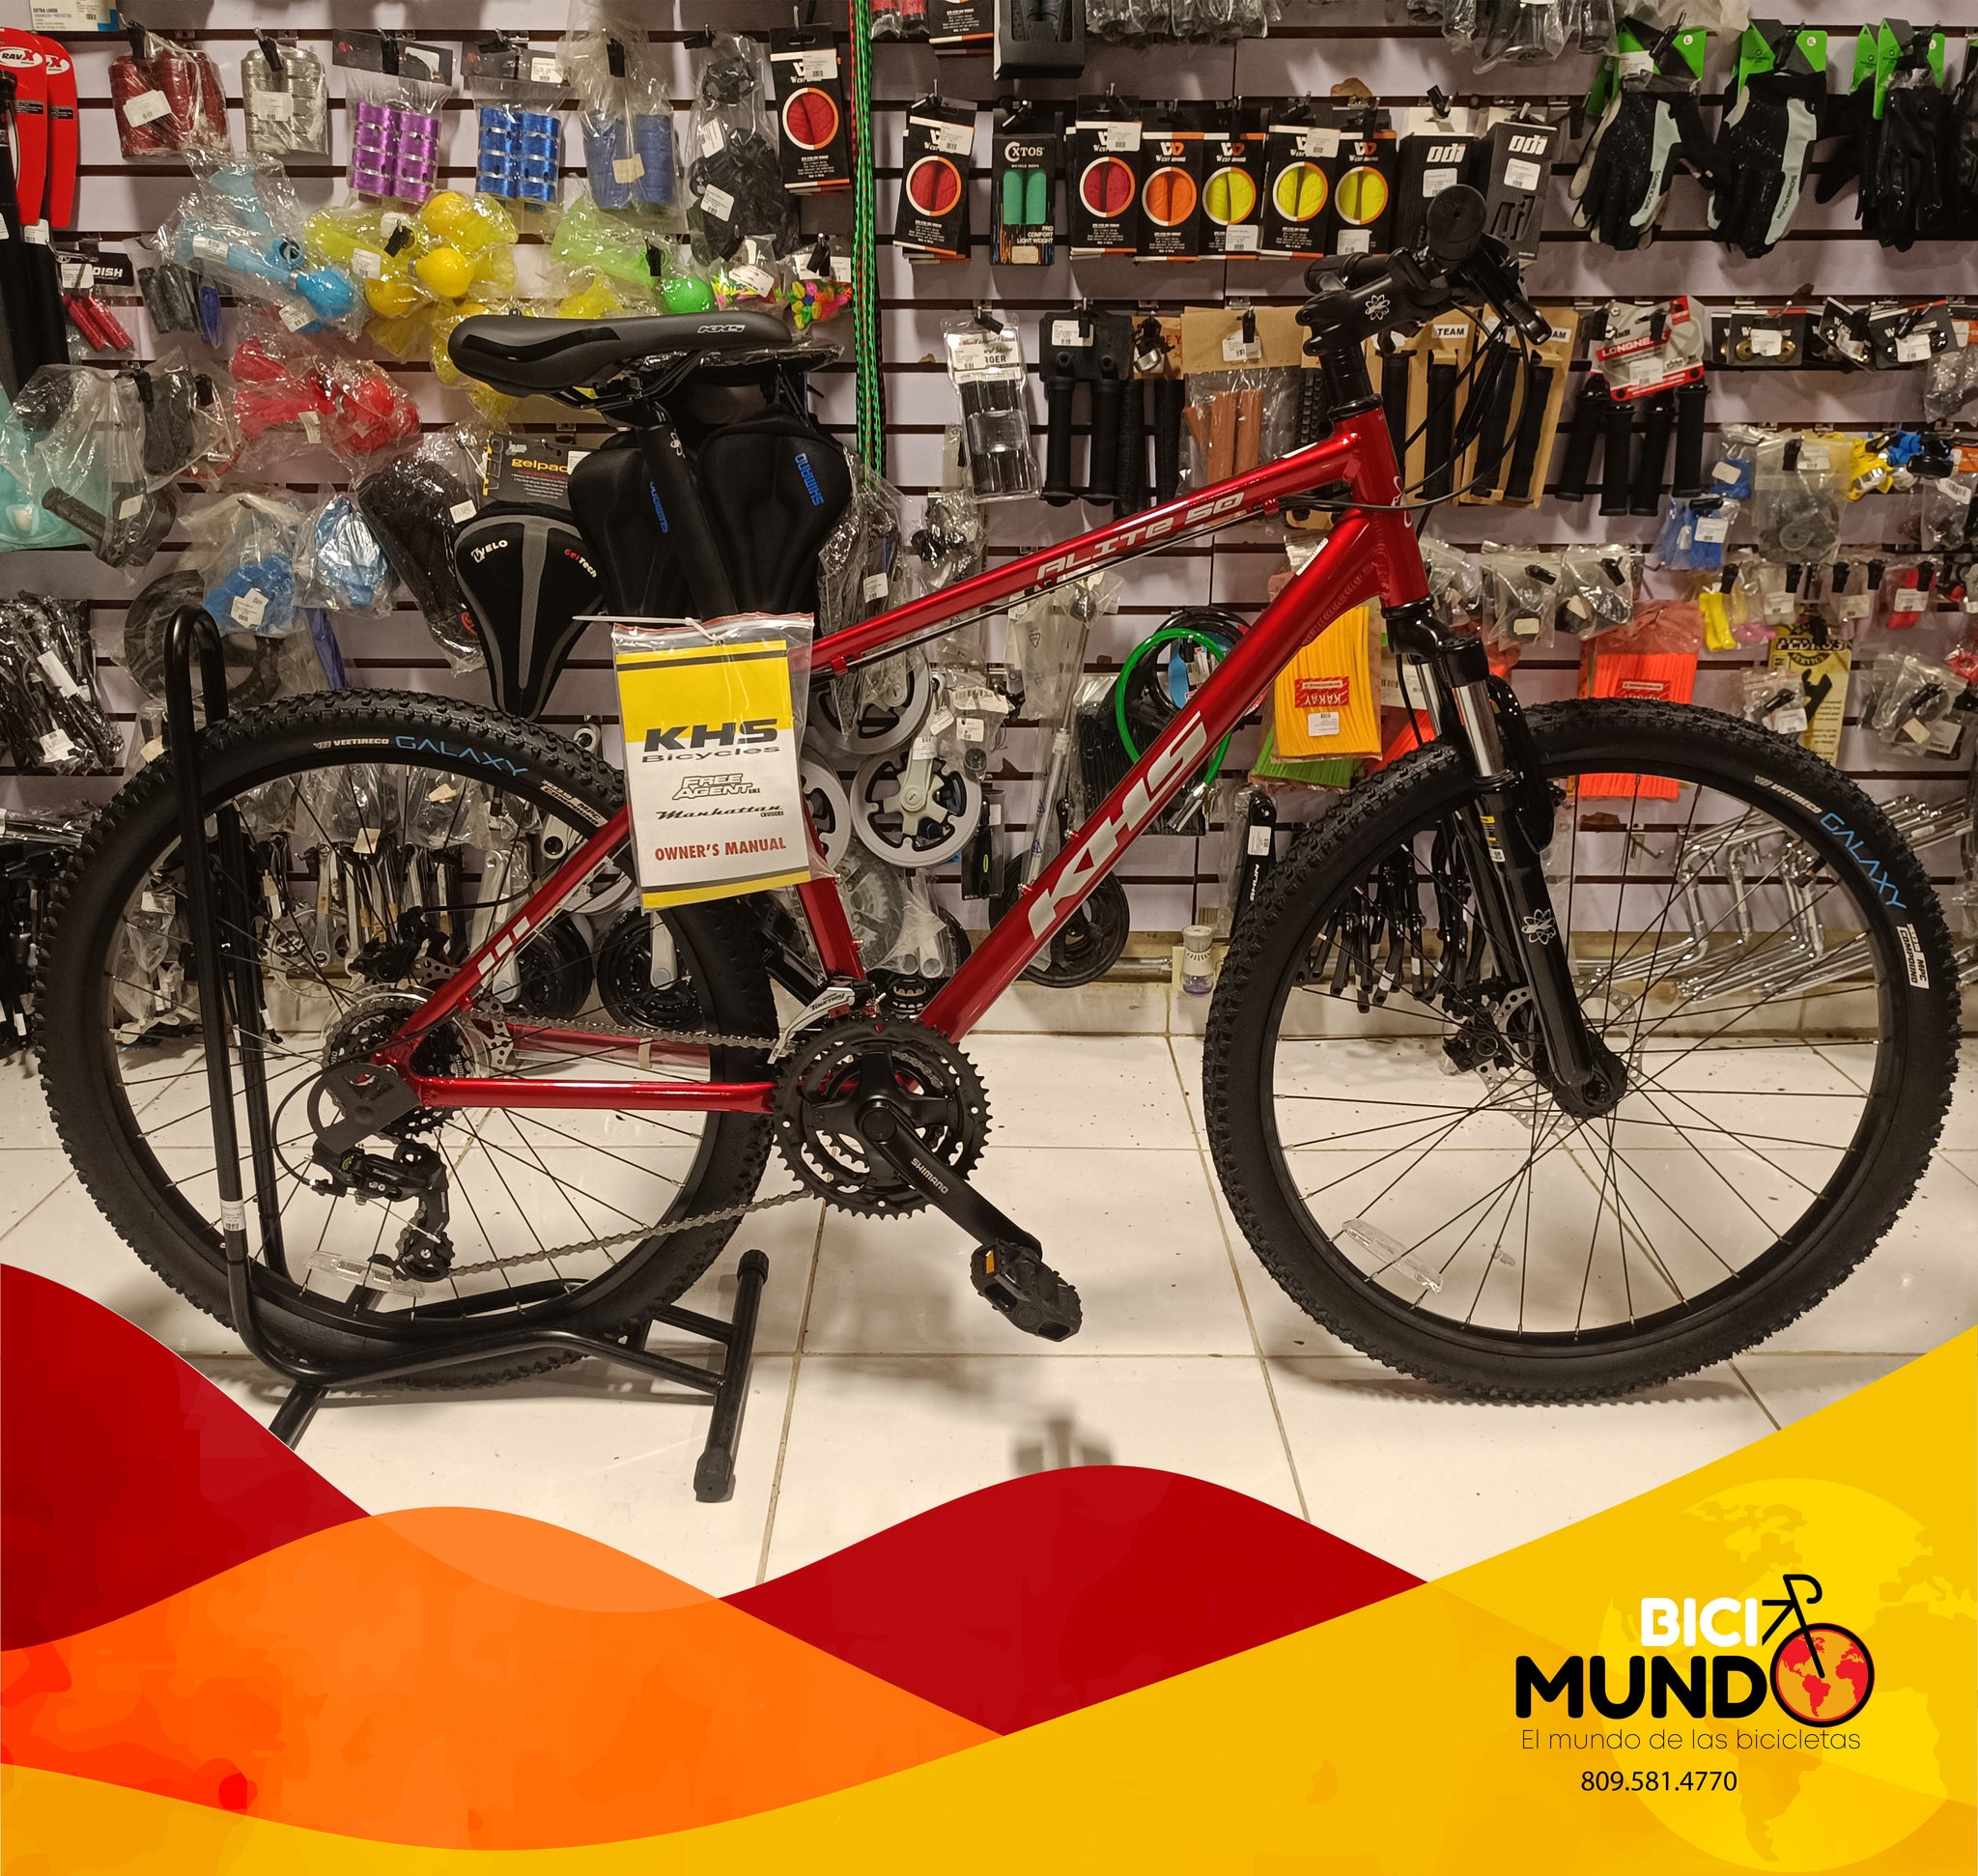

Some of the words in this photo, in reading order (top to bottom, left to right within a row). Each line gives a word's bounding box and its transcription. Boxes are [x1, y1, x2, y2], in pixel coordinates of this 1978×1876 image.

[1437, 327, 1465, 336] TEAM
[795, 452, 825, 506] SHIMANO
[1037, 517, 1173, 582] ALITE
[644, 719, 777, 753] KHS
[394, 735, 528, 777] GALAXY
[642, 747, 780, 763] Bicycles
[672, 782, 753, 801] AGENT
[682, 773, 744, 789] FREE
[656, 804, 782, 820] Manhattan
[1028, 711, 1207, 940] KHS
[655, 842, 720, 862] OWNER'S
[724, 837, 786, 857] MANUAL
[1821, 812, 1907, 909] GALAXY
[1900, 929, 1918, 983] COMPOUND
[1916, 958, 1927, 982] MPC
[911, 1157, 948, 1194] SHIMANO
